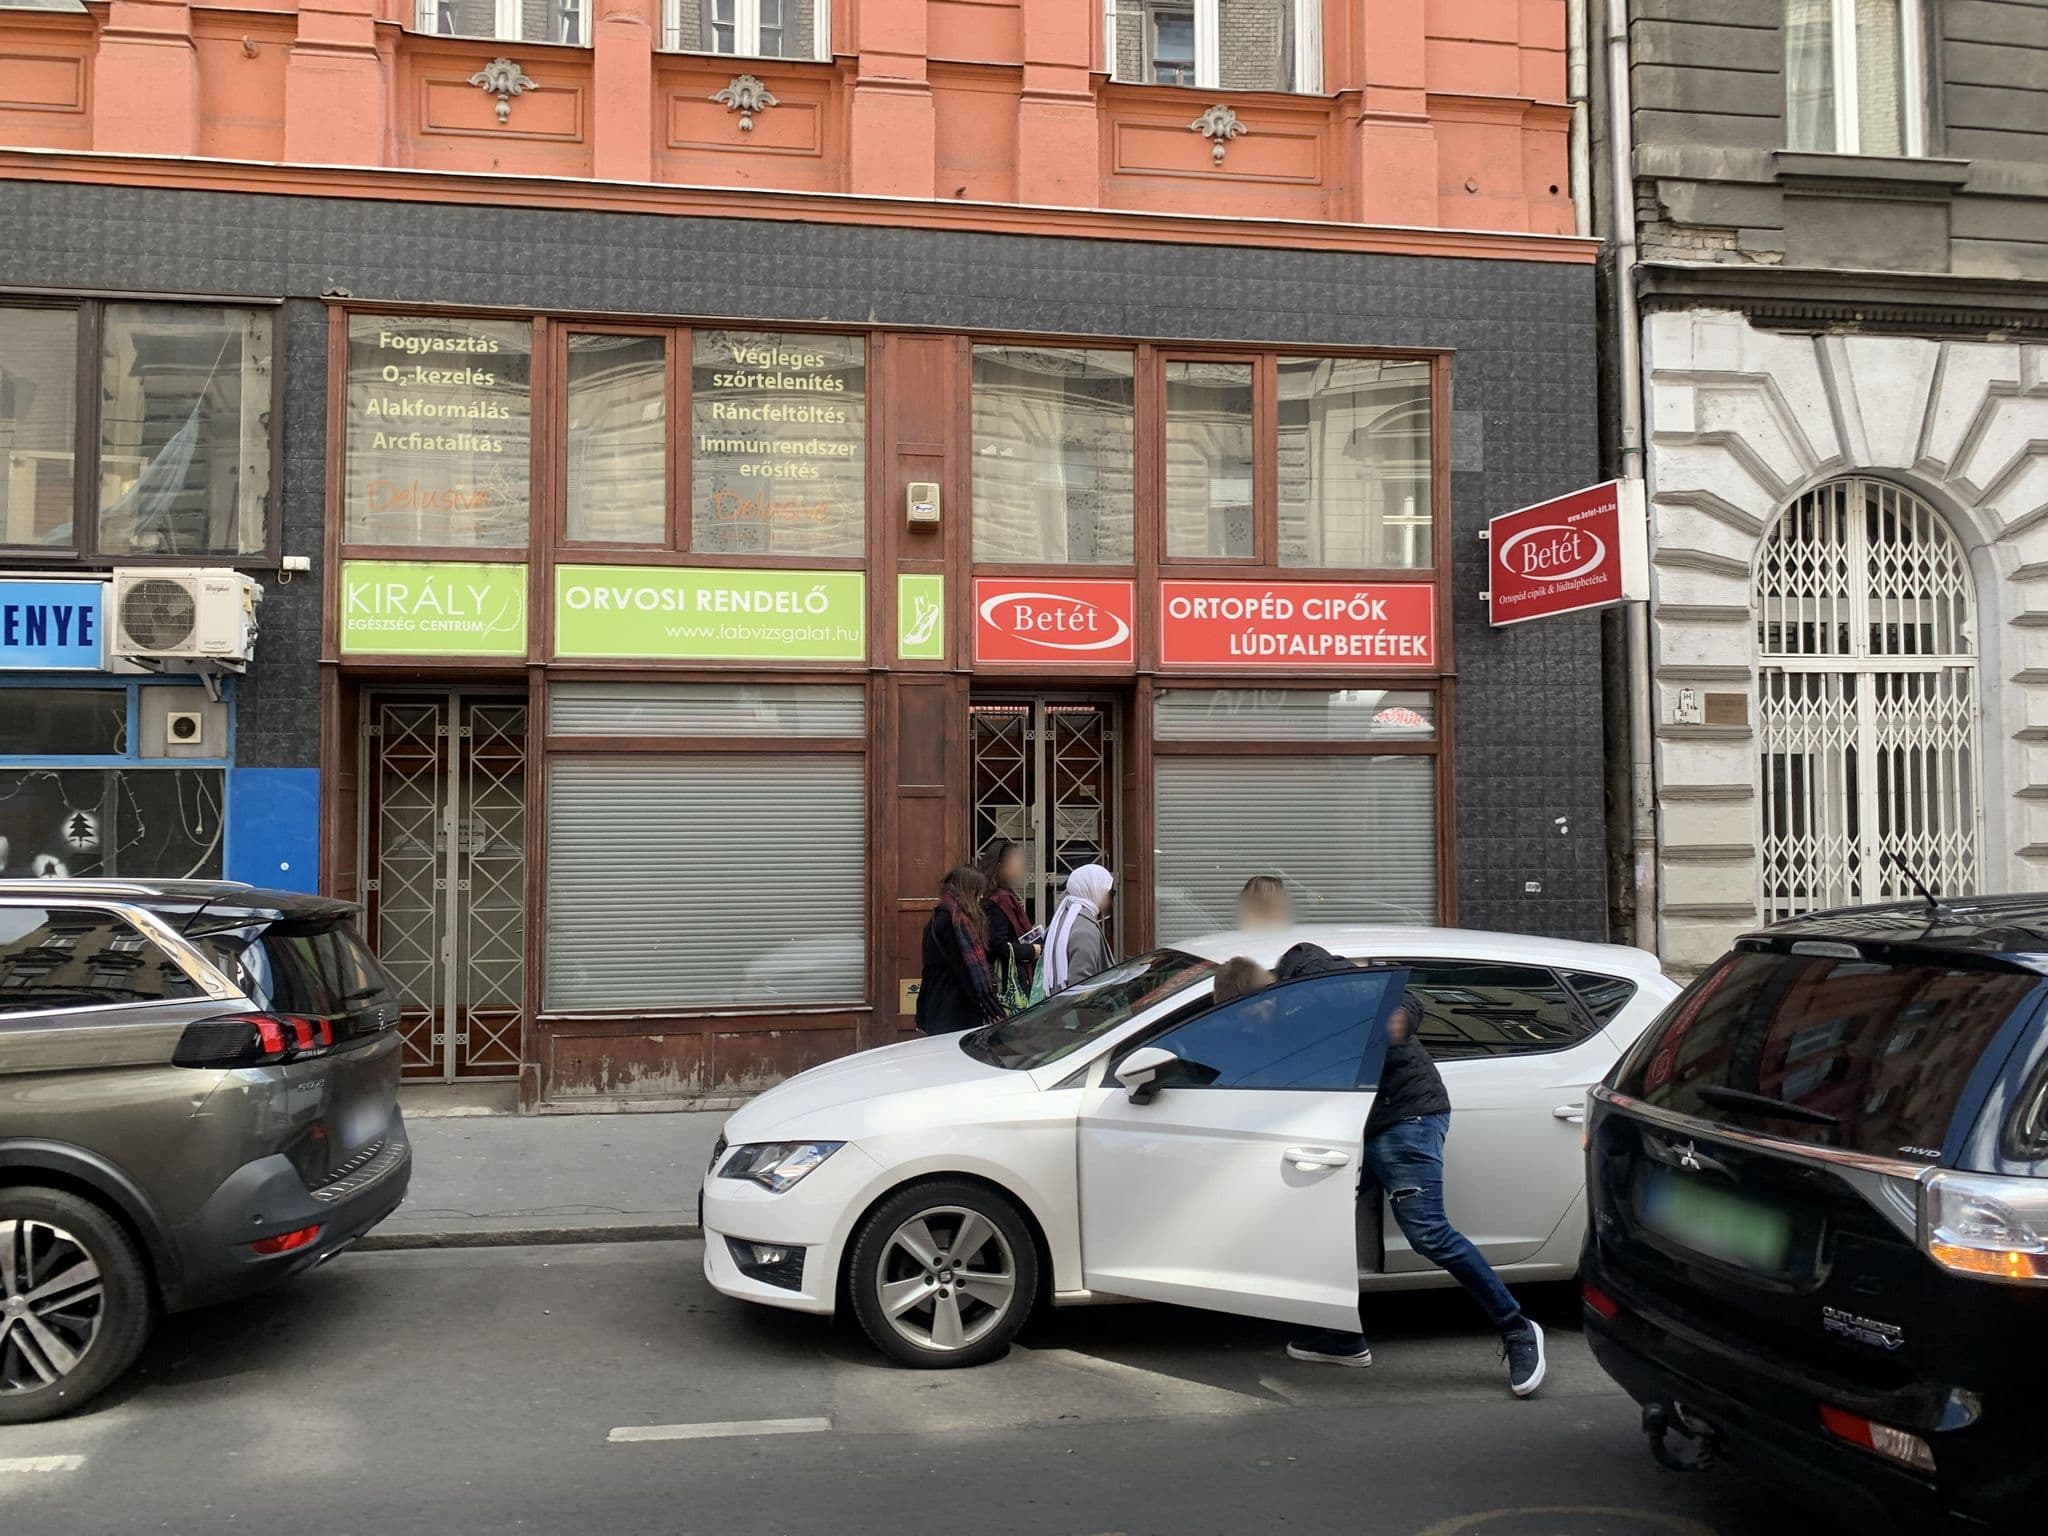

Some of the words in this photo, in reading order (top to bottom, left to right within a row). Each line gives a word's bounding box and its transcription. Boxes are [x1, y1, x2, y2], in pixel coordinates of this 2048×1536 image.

[380, 332, 499, 354] Fogyasztás
[733, 347, 824, 370] Végleges
[713, 371, 844, 391] szőrtelenítés
[366, 398, 510, 419] Alakformálás
[712, 402, 845, 423] Ráncfeltöltés
[372, 432, 503, 452] Arcfiatalítás
[700, 435, 857, 457] Immunrendszer
[739, 461, 820, 478] erősítés
[1522, 532, 1581, 573] Betét
[348, 575, 491, 616] KIRÁLY
[566, 587, 685, 611] ORVOSI
[696, 585, 829, 614] RENDELŐ
[1168, 591, 1293, 620] ORTOPÉD
[1302, 592, 1388, 621] CIPŐK
[4, 605, 93, 646] ENYE
[347, 616, 416, 632] EGÉSZSÉG
[419, 620, 484, 632] CENTRUM
[1013, 604, 1098, 633] Betét
[664, 624, 860, 644] www.labvizsgalat.hu
[1230, 627, 1428, 657] LÚDTALPBETÉTEK
[1898, 1146, 1941, 1157] 4WD
